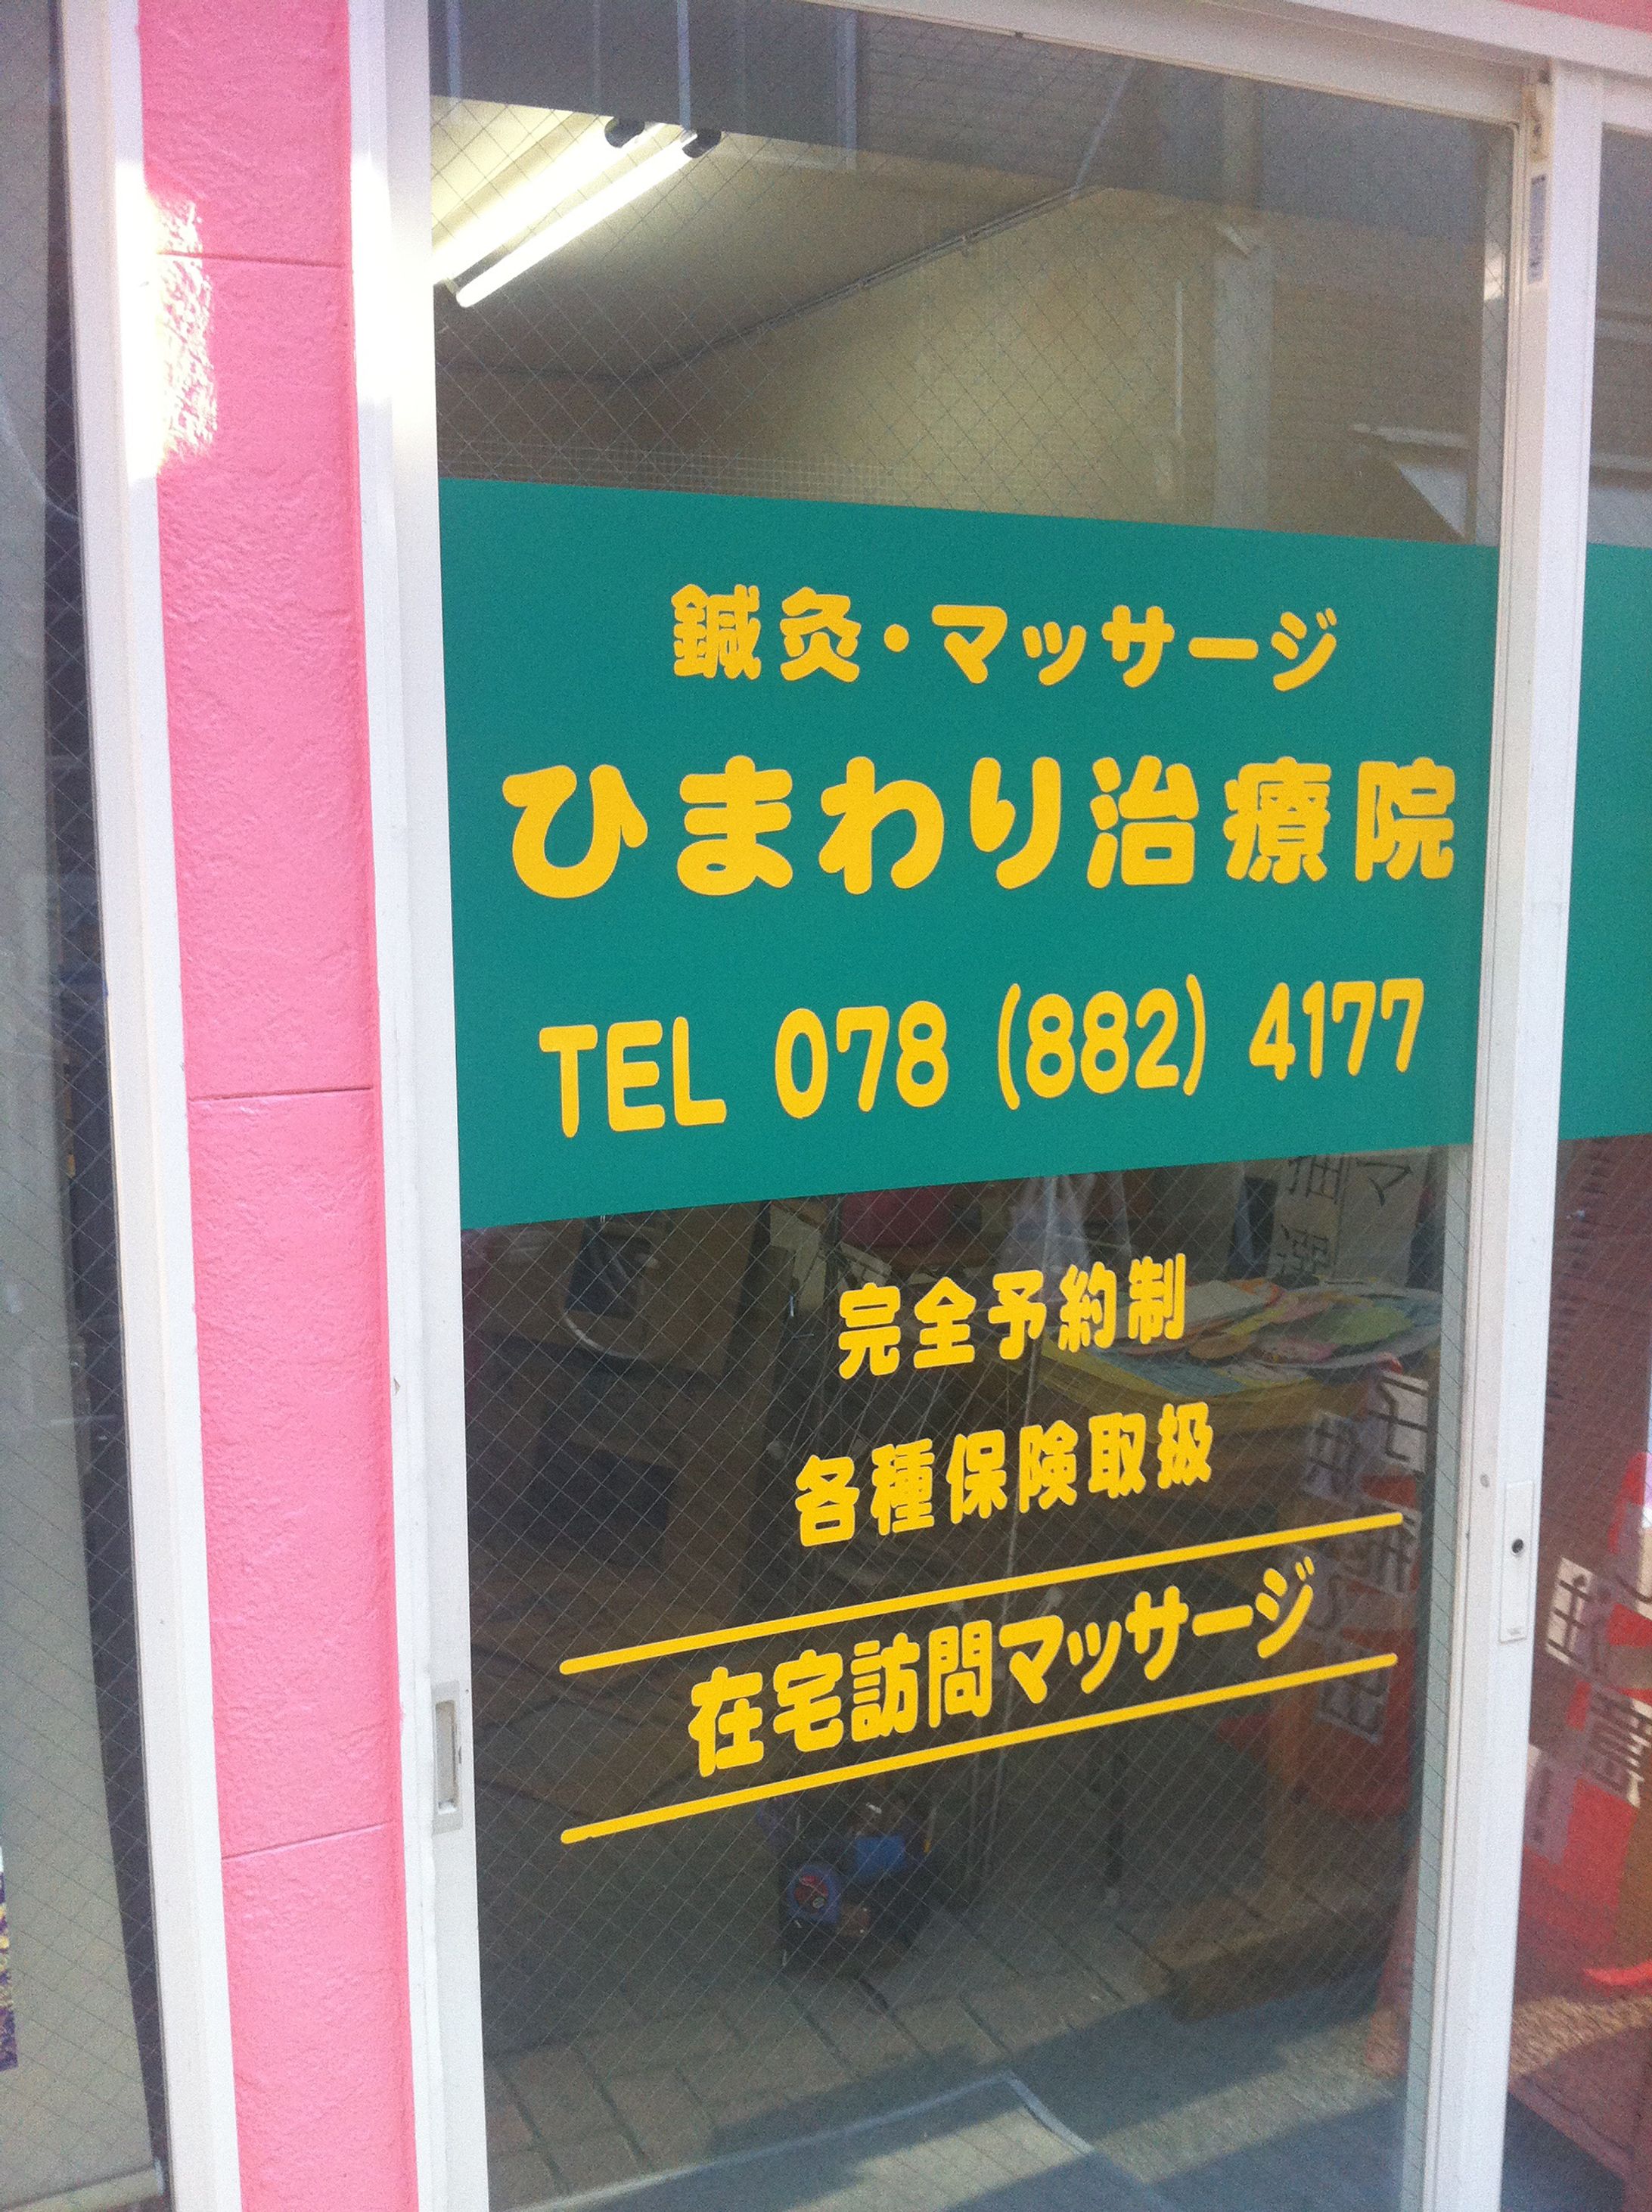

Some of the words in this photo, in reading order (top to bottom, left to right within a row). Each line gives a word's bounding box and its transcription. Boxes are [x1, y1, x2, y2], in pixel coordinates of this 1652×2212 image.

[671, 584, 1338, 692] 鍼灸・マッサージ
[502, 755, 1456, 899] ひまわり治療院
[539, 1017, 728, 1139] TEL
[775, 1001, 949, 1120] 078
[997, 974, 1206, 1111] (882)
[1248, 978, 1425, 1082] 4177
[837, 1253, 1187, 1381] 完全予約制
[794, 1400, 1214, 1548] 各種保険取扱
[688, 1557, 1316, 1779] 在宅訪問マッサージ
